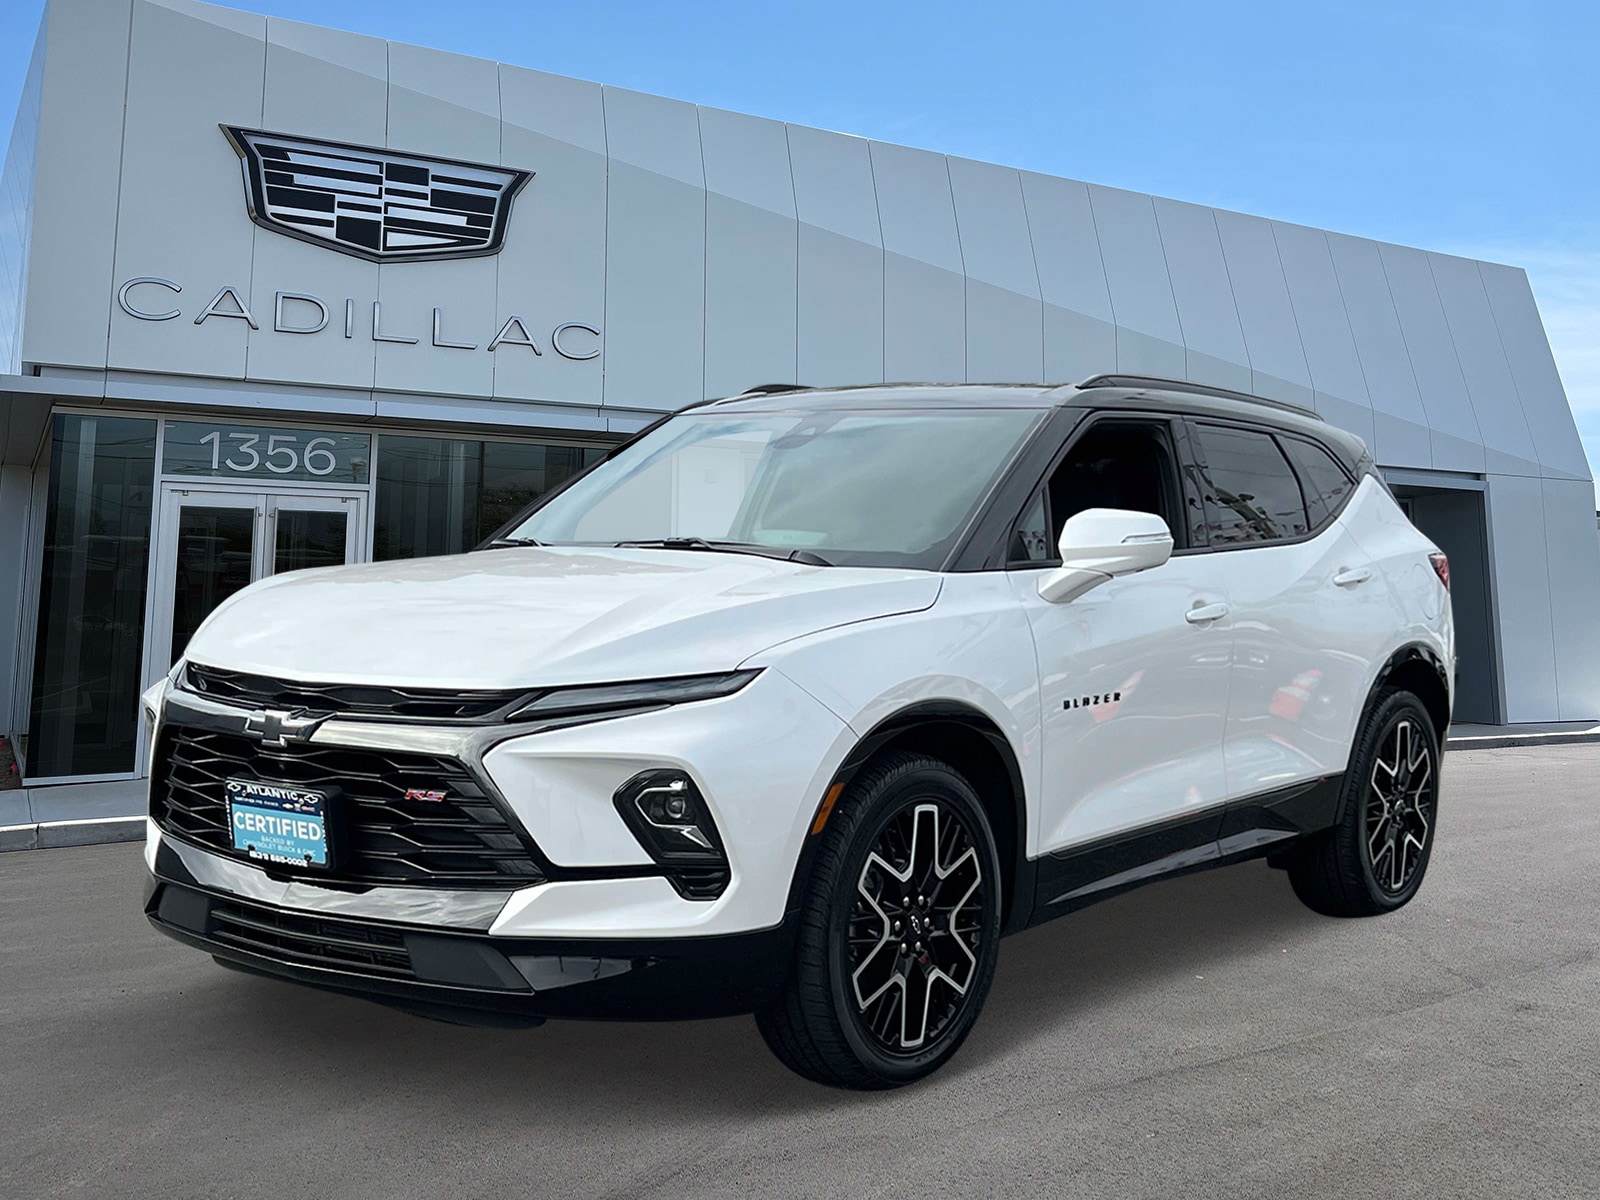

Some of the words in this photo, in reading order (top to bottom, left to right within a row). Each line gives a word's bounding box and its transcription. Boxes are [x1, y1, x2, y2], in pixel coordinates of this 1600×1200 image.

[117, 275, 602, 361] CADILLAC
[199, 430, 337, 476] 1356
[1063, 692, 1121, 711] BLAZER
[246, 785, 299, 800] ATLANTIC
[404, 788, 447, 802] RS
[233, 811, 321, 841] CERTIFIED
